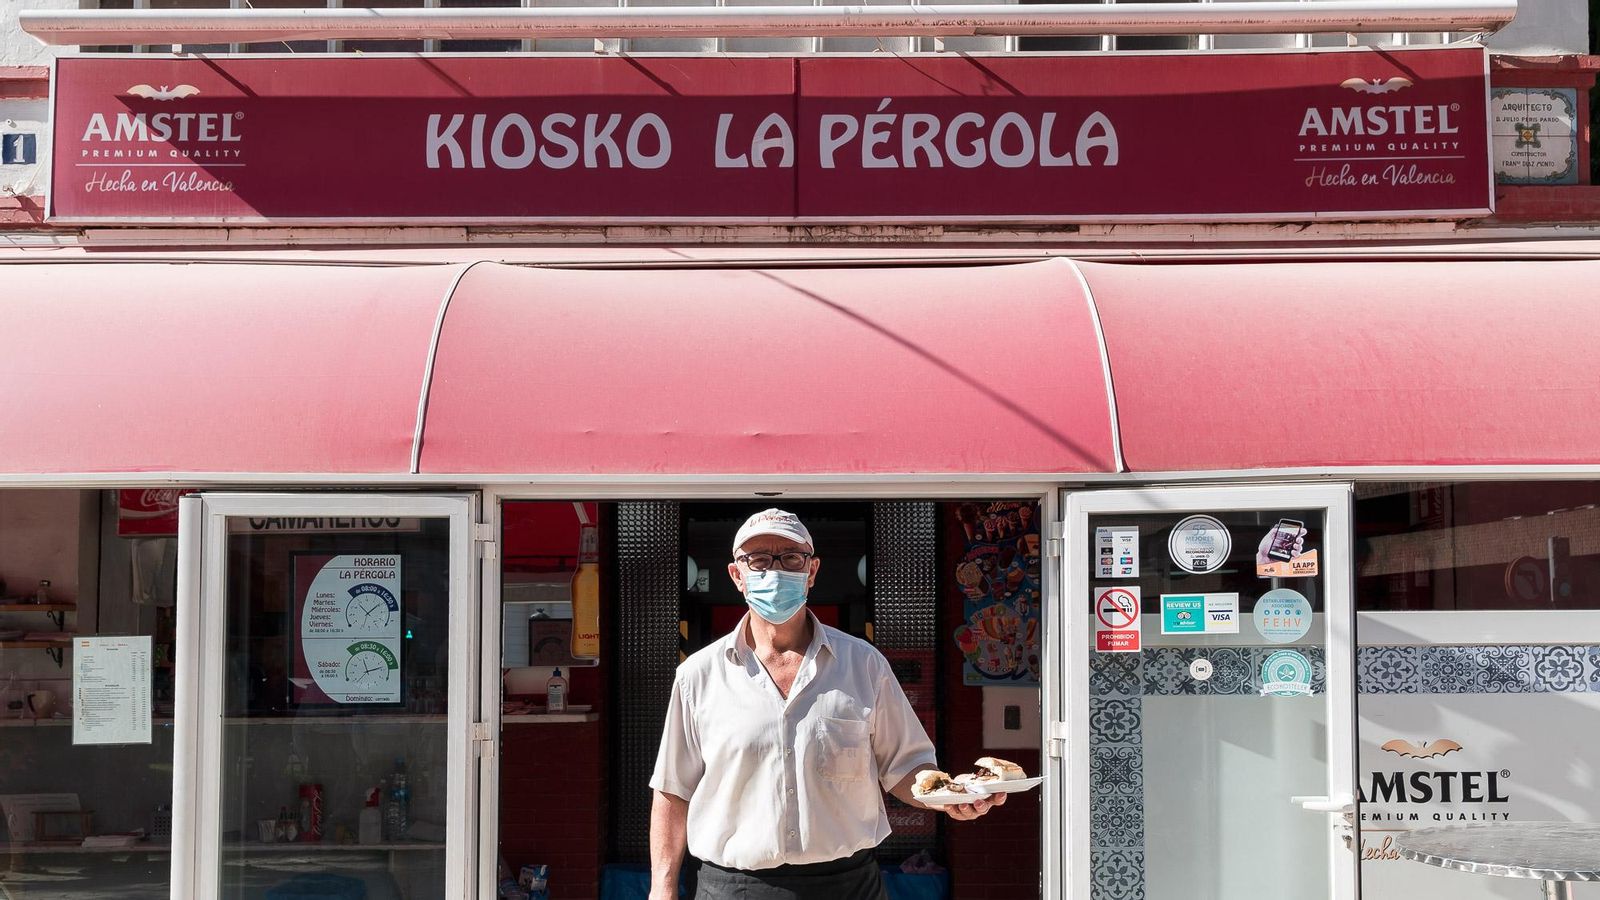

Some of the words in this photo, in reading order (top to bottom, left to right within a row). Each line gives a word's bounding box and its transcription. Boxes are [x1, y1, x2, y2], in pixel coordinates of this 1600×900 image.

[1501, 103, 1553, 112] ARQUITECTO
[424, 112, 673, 170] KIOSKO
[714, 112, 794, 169] LA
[818, 97, 1120, 169] PÉRGOLA
[12, 134, 27, 163] 1
[1299, 143, 1376, 152] PREMIUM
[1387, 142, 1459, 151] QUALITY
[82, 149, 158, 158] PREMIUM
[169, 149, 241, 158] QUALITY
[1305, 163, 1358, 187] Hecha
[1361, 172, 1379, 185] en
[1382, 164, 1456, 187] Valencia
[85, 169, 137, 192] Hecha
[141, 179, 159, 191] en
[162, 170, 235, 193] Valencia
[1192, 524, 1207, 536] 55
[353, 557, 396, 567] HORARIO
[339, 570, 352, 580] LA
[353, 567, 396, 580] PÉRGOLA
[360, 585, 378, 593] 08:00
[1211, 613, 1231, 621] VISA
[309, 620, 334, 628] Viernes:
[317, 660, 341, 668] Sábado:
[345, 694, 374, 703] Domingo:
[1361, 812, 1420, 821] EMIUM
[1432, 812, 1510, 822] QUALITY
